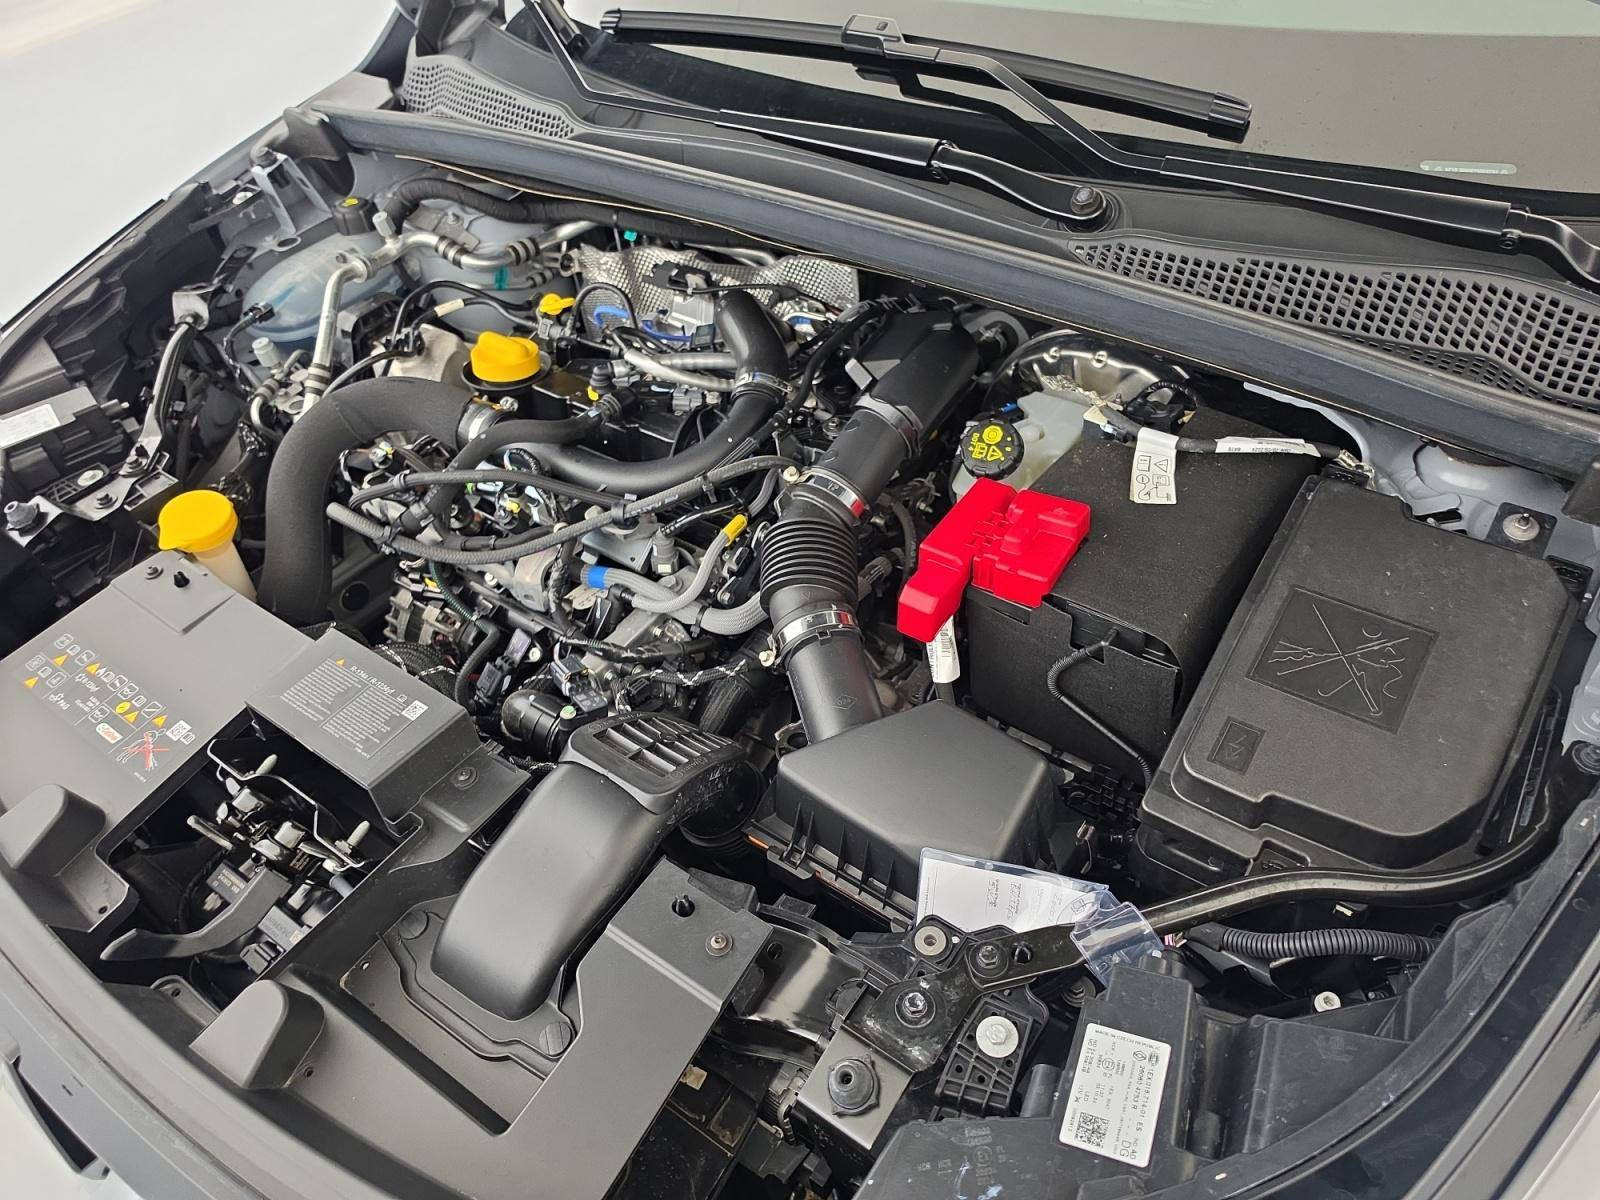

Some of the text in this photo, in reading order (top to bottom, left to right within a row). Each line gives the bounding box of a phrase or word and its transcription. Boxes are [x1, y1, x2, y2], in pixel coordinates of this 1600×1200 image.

[971, 432, 980, 446] DOT
[370, 677, 396, 695] R-1234yf
[1118, 1139, 1131, 1158] DG
